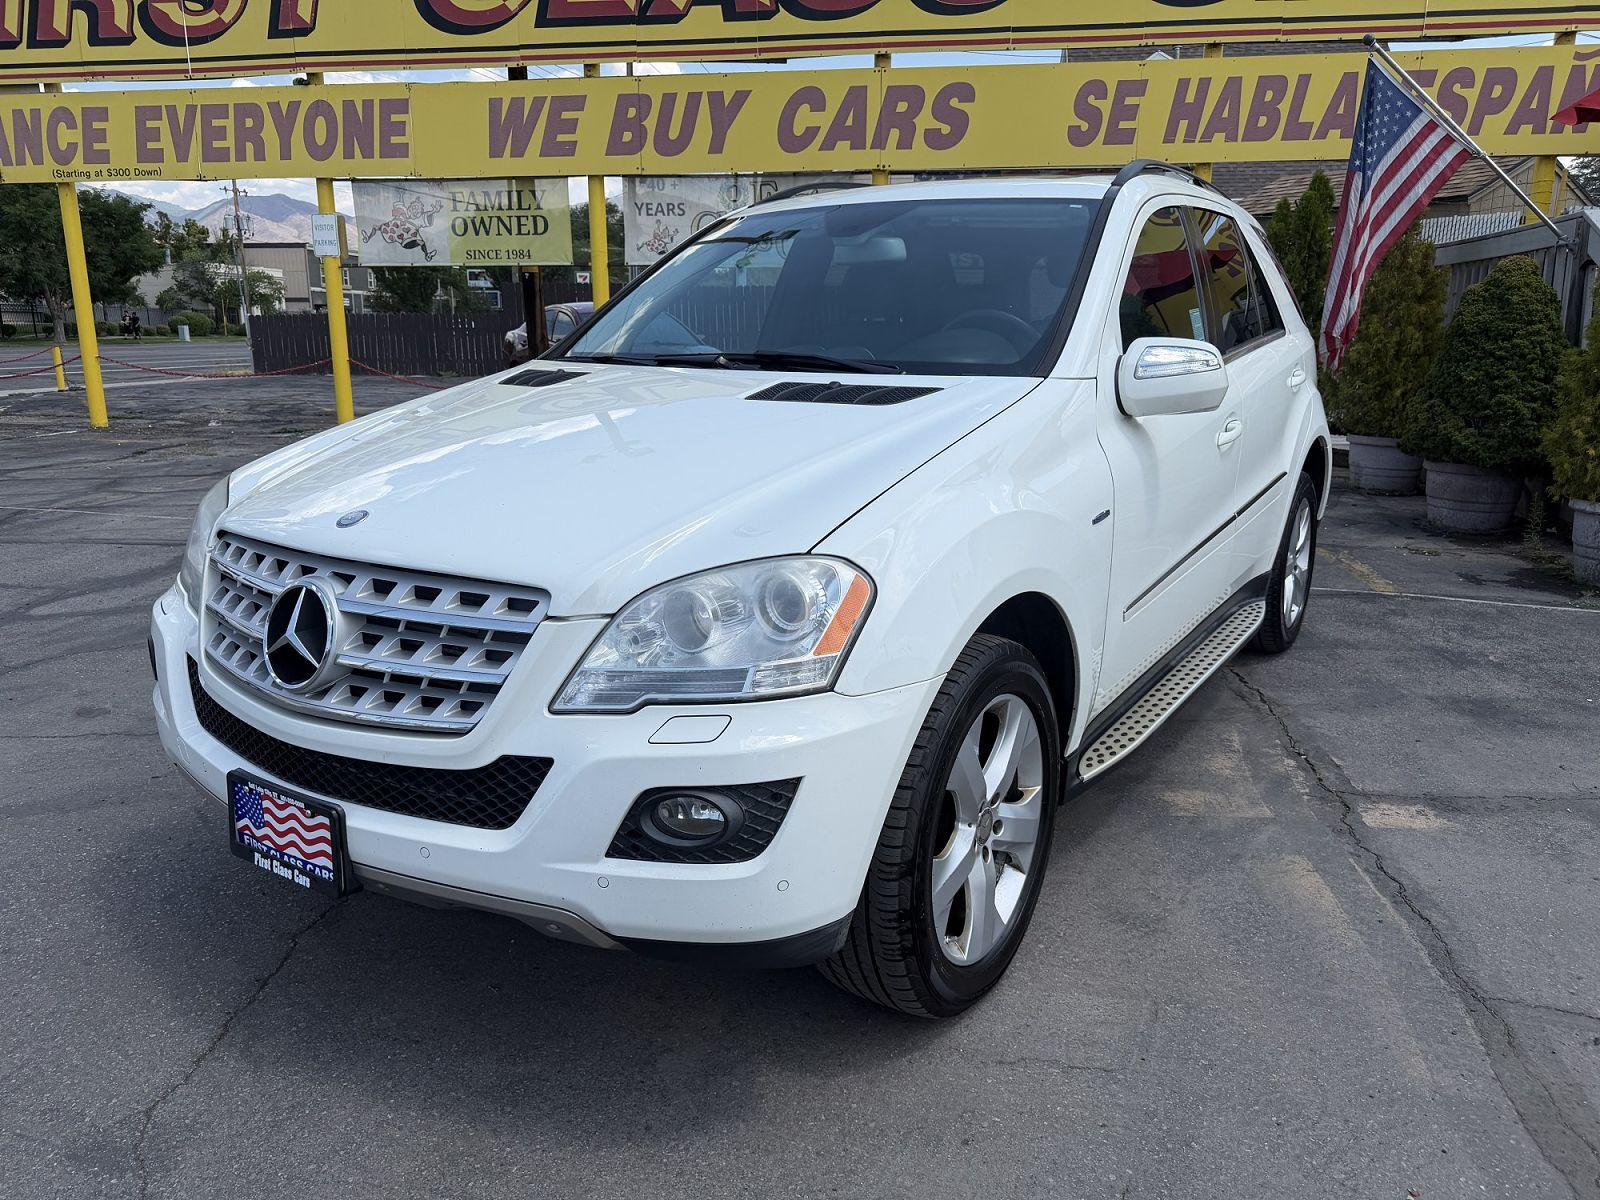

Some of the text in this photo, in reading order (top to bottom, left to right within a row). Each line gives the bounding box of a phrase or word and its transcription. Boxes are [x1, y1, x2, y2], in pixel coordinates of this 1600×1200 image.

[135, 98, 410, 164] EVERYONE
[488, 94, 588, 158] WE
[605, 89, 752, 157] BUY
[777, 81, 976, 154] CARS
[1067, 78, 1149, 147] SE
[1162, 72, 1359, 144] HABLA
[52, 169, 91, 179] (Starting
[94, 169, 103, 177] at
[134, 166, 162, 177] Down)
[449, 189, 546, 212] FAMILY
[634, 201, 686, 217] YEARS
[314, 223, 335, 231] VISITOR
[451, 214, 549, 237] OWNED
[314, 239, 337, 247] PARKING
[466, 248, 532, 260] SINCE 1984
[254, 851, 311, 889] First Class Cars
